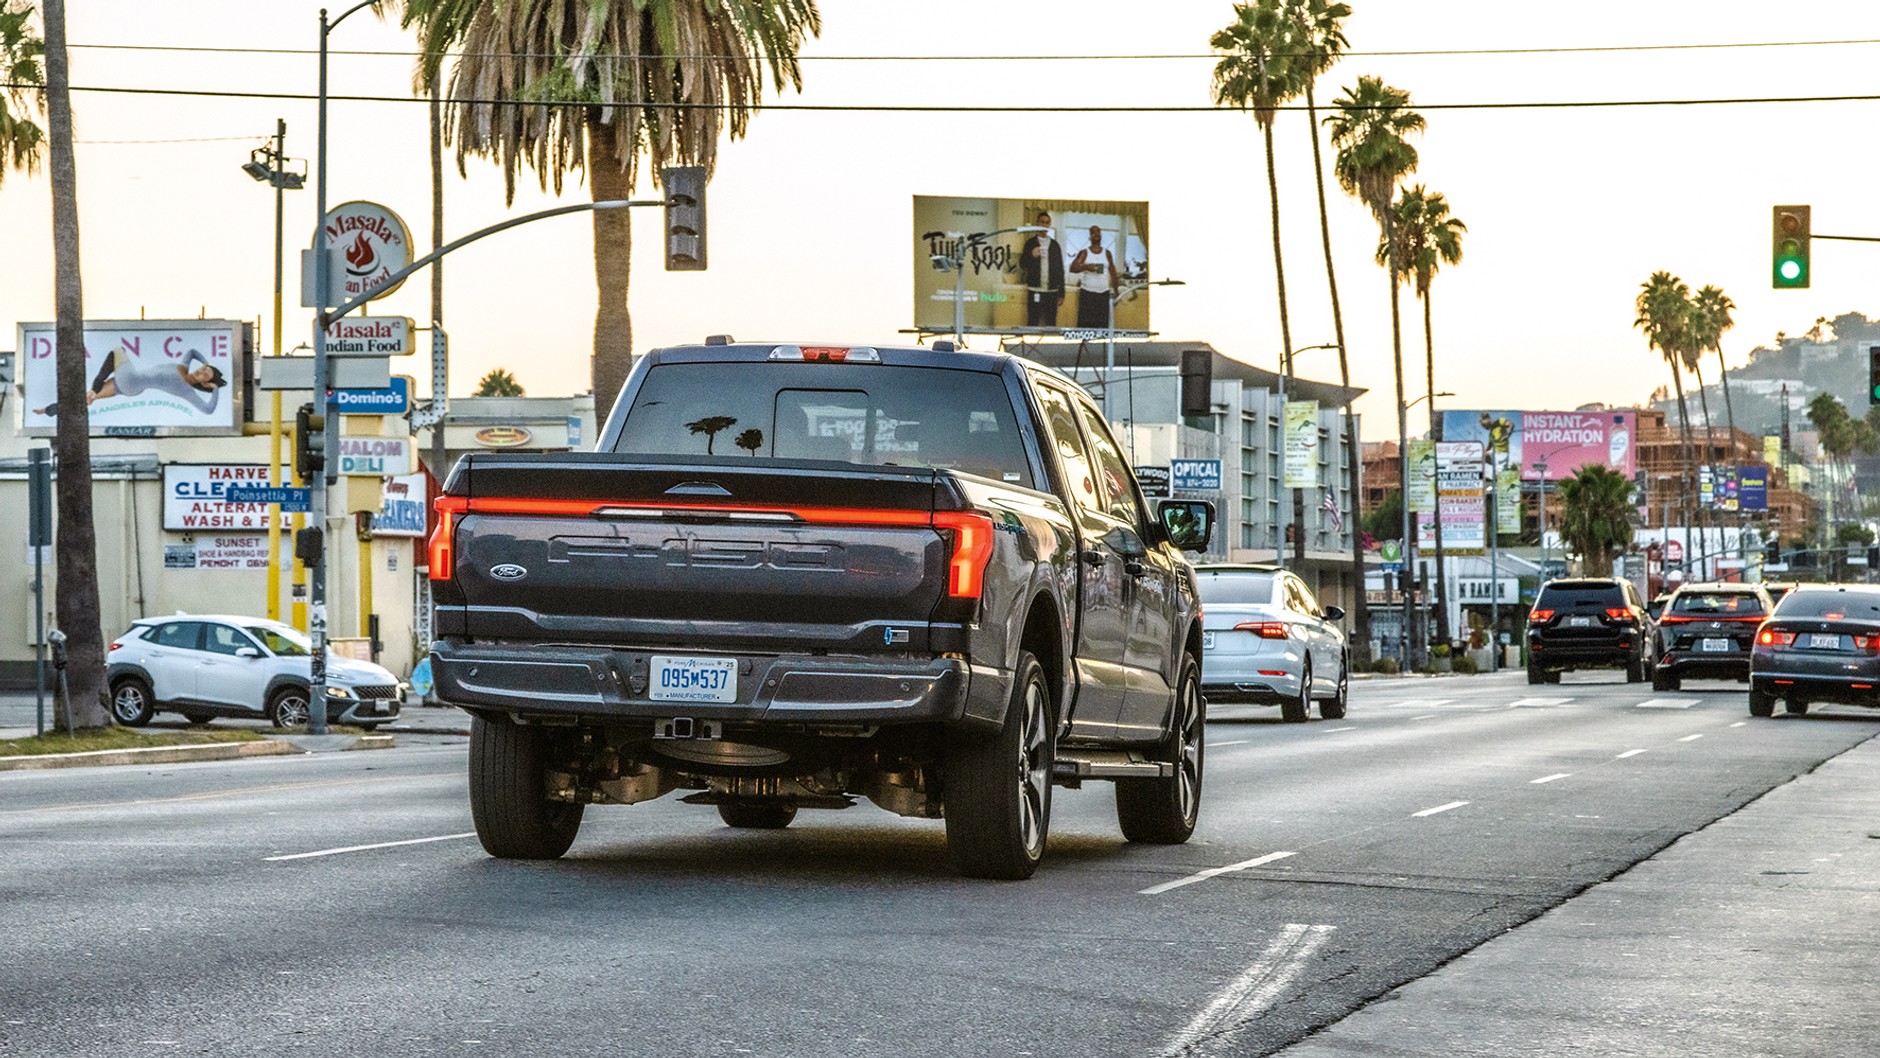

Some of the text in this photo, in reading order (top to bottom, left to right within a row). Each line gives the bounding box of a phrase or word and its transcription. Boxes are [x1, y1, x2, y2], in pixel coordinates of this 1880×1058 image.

[325, 214, 393, 245] Masala
[980, 291, 1007, 302] hulu
[326, 321, 392, 338] Masala
[32, 335, 228, 359] DNCE
[326, 339, 401, 352] ndian Food
[337, 391, 403, 404] Domino's
[98, 400, 146, 416] ANGELES
[1523, 415, 1583, 428] INSTANT
[107, 426, 152, 435] LAMAR
[1523, 430, 1603, 443] HYDRATION
[339, 441, 402, 456] HALOM
[342, 457, 384, 472] DELI
[1174, 462, 1218, 477] OPTICAL
[209, 467, 272, 480] HARVE
[1135, 468, 1169, 480] LYWOOD
[233, 490, 303, 501] Poinsettia Pl
[191, 503, 268, 513] ALTERAT
[183, 516, 234, 526] WASH
[241, 516, 252, 527] &
[215, 538, 261, 548] SUNSET
[223, 550, 256, 558] HANDBAG
[1470, 583, 1505, 599] RAMN
[662, 668, 728, 689] 095M537
